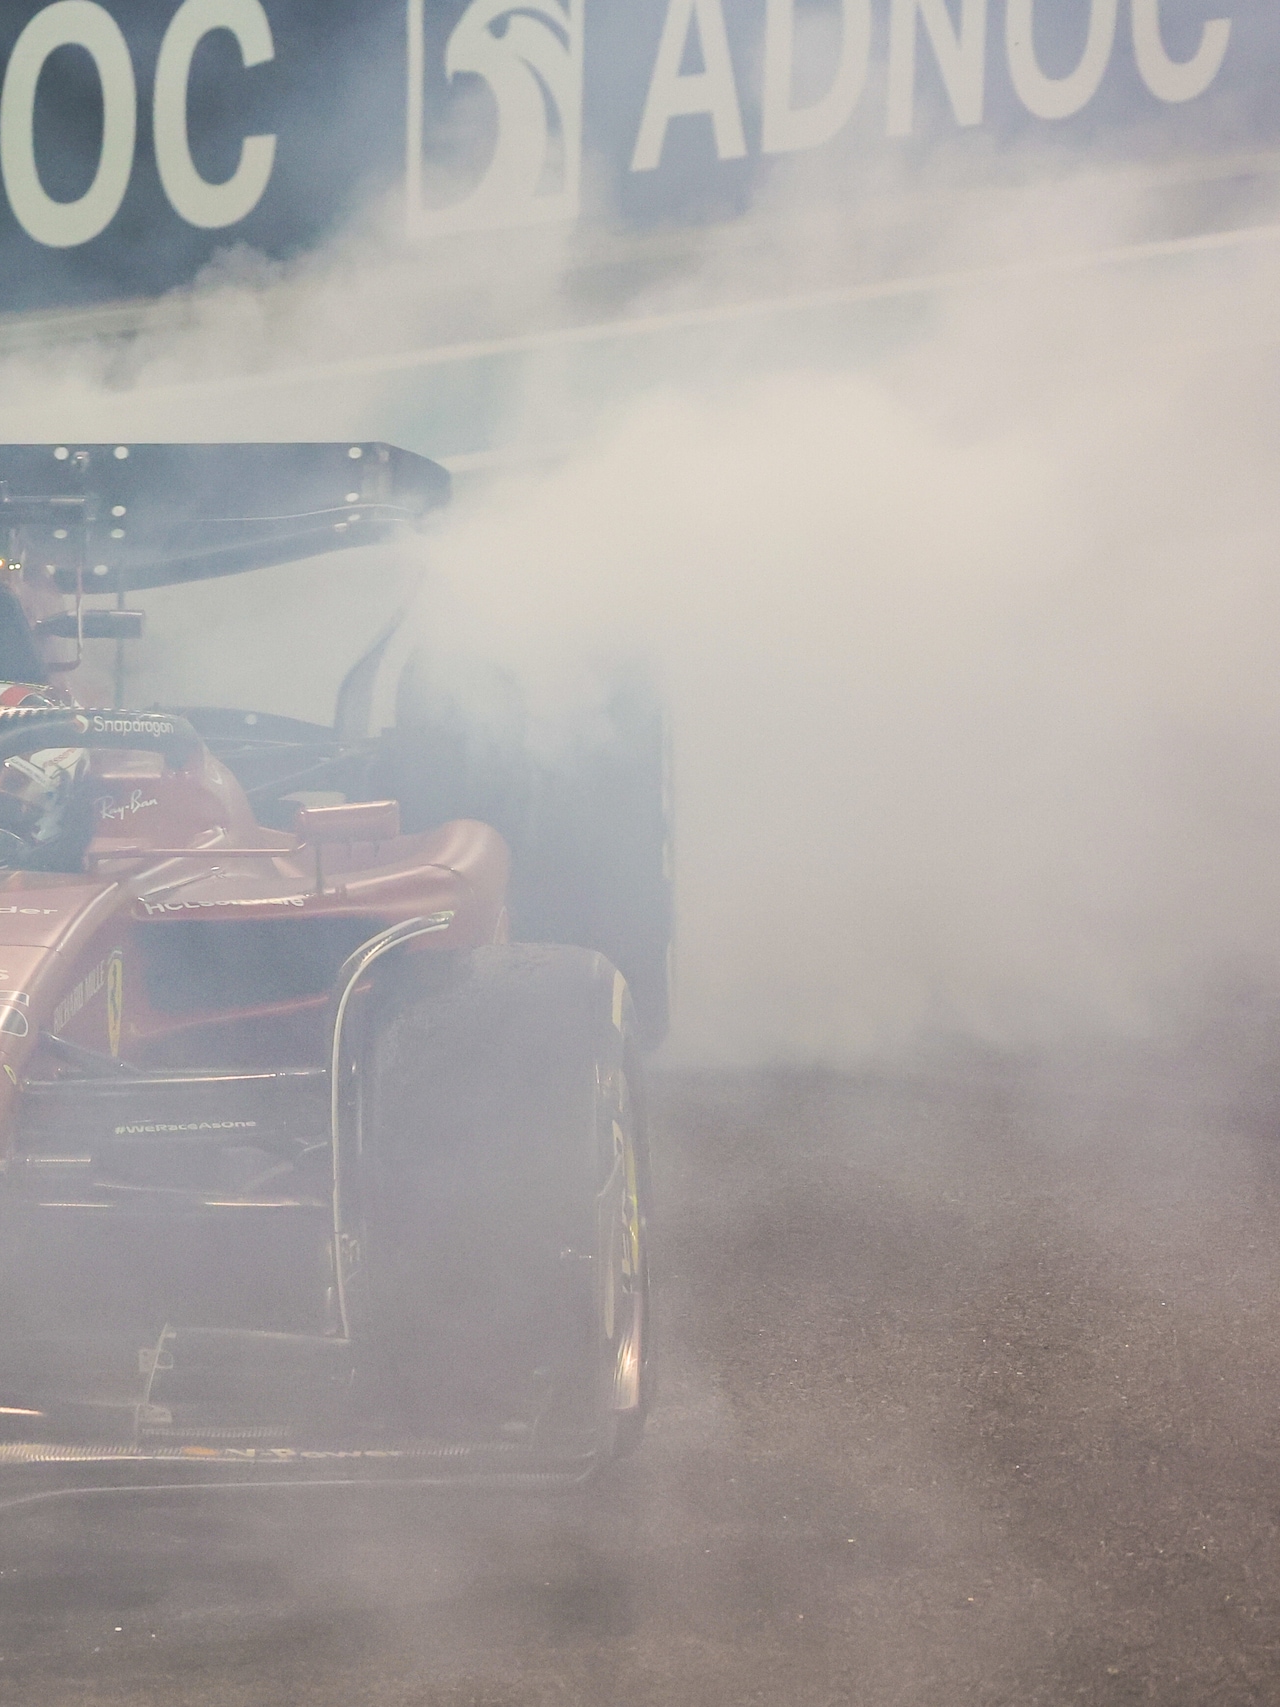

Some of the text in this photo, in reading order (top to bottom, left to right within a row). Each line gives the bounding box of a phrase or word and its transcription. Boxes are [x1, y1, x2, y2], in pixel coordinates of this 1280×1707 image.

[94, 716, 175, 739] Snapdragon
[94, 788, 159, 821] Ray-Ban
[114, 1120, 257, 1135] #WeRaceAsOne
